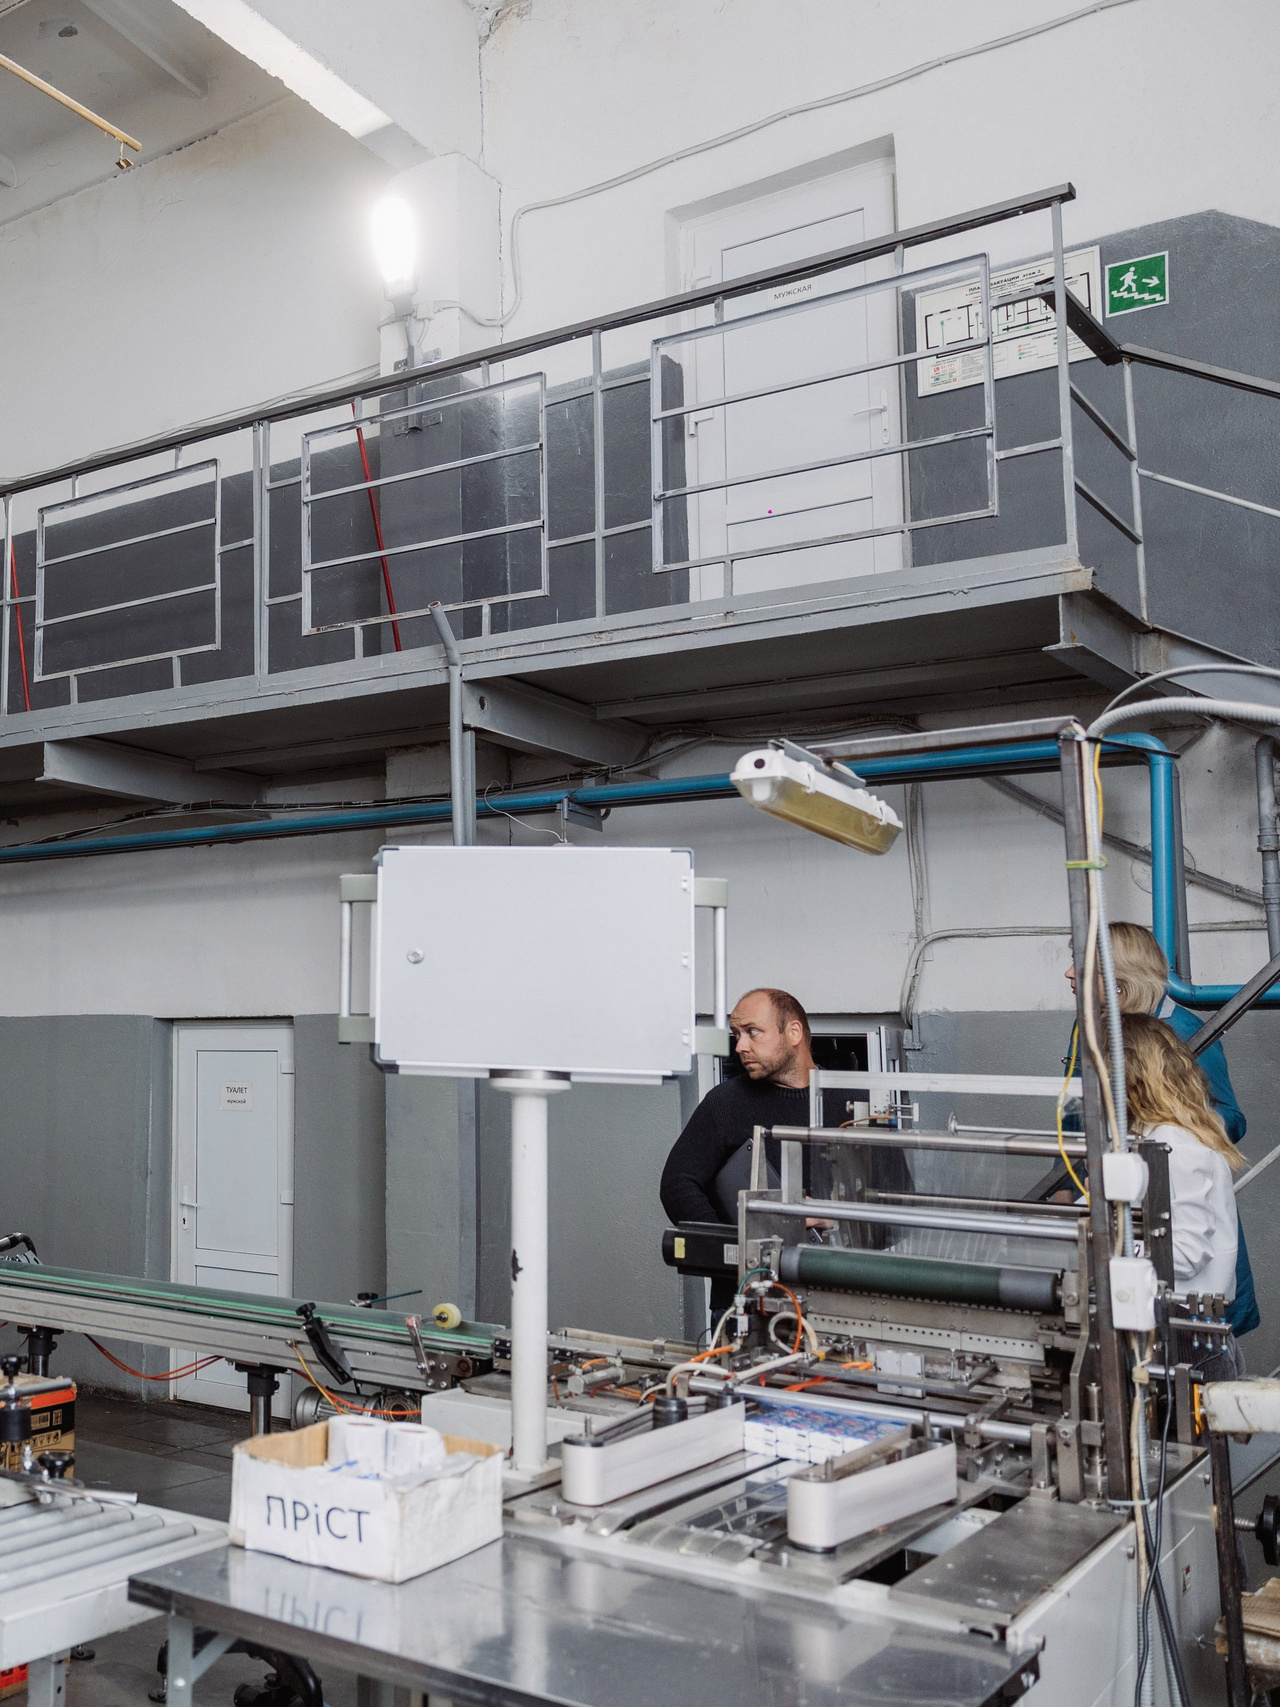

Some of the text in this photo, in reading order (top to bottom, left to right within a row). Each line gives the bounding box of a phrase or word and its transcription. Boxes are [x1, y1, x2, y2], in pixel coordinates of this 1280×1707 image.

[990, 275, 1020, 286] ВАКУАЦИИ
[773, 284, 812, 300] МУЖСКАЯ
[226, 1086, 248, 1094] ТУАЛЕТ
